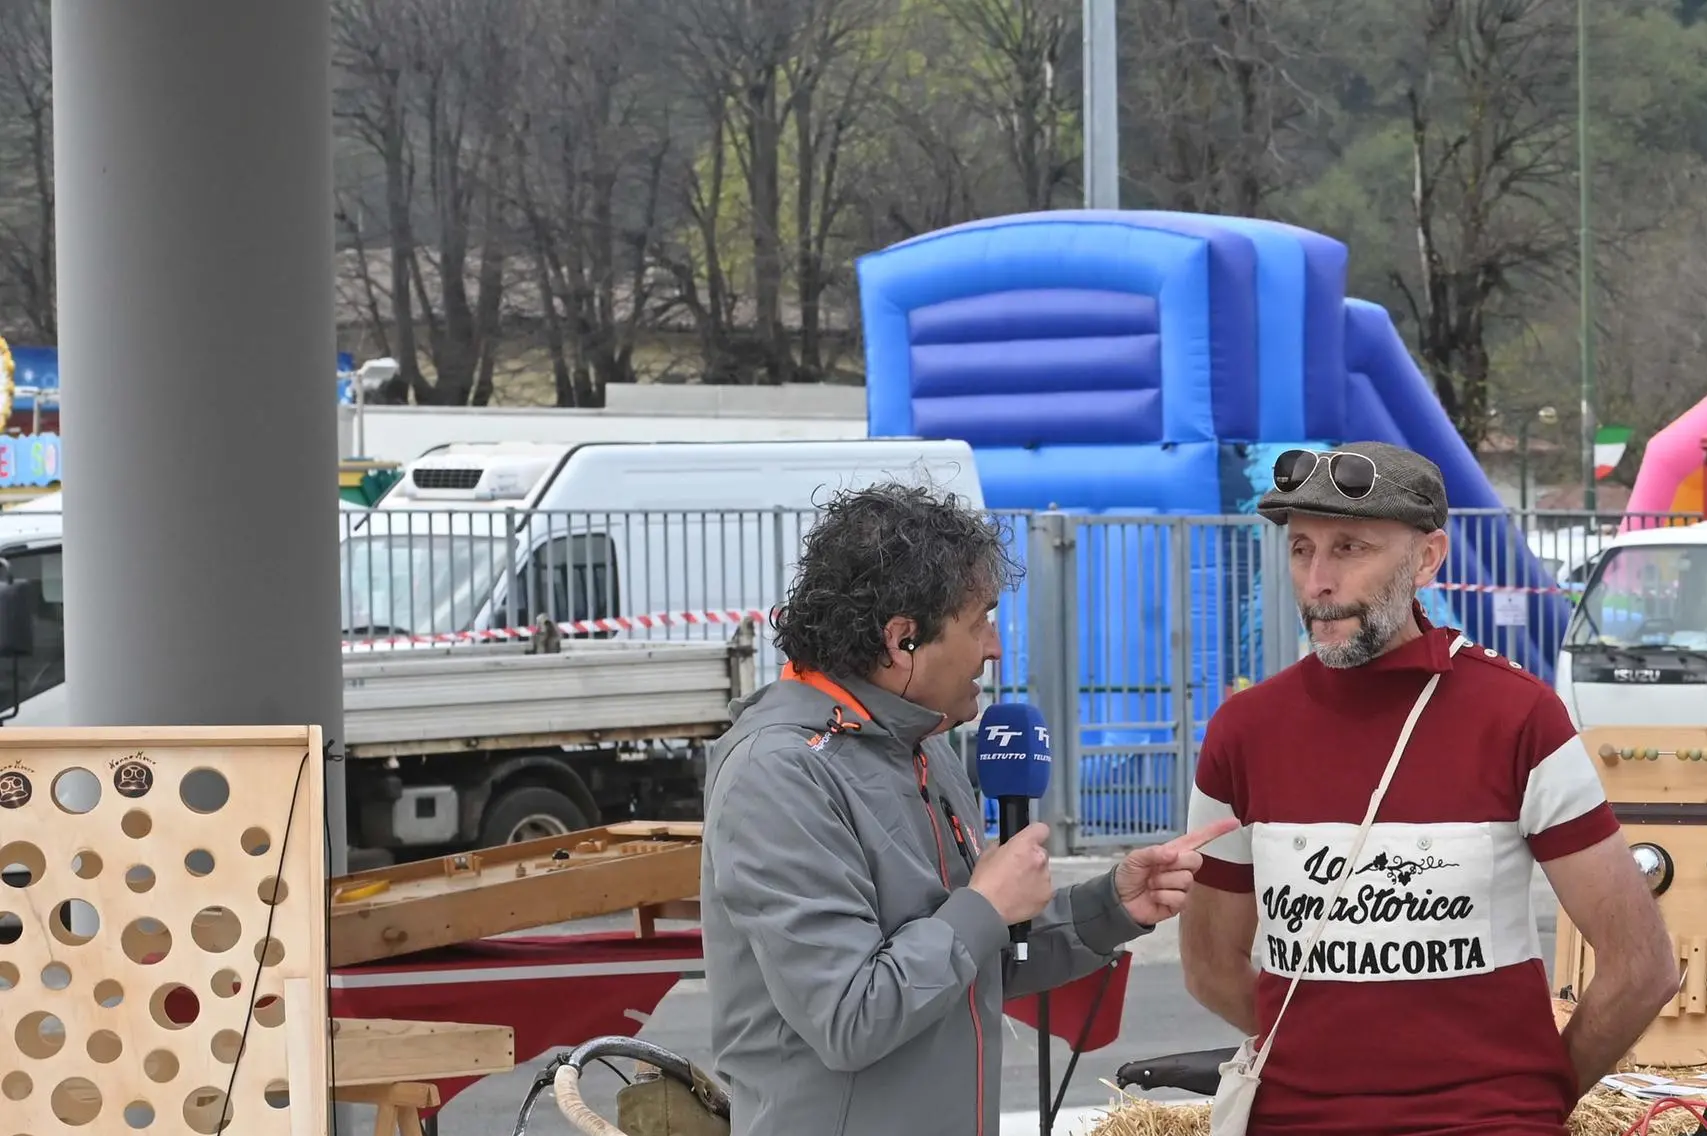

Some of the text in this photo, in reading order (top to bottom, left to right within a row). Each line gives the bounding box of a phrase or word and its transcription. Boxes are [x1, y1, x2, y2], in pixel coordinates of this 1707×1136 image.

[1614, 669, 1661, 682] ISUZU
[980, 752, 1027, 761] TELETUTTO
[1304, 846, 1353, 885] La
[1267, 934, 1486, 975] FRANCIACORTA
